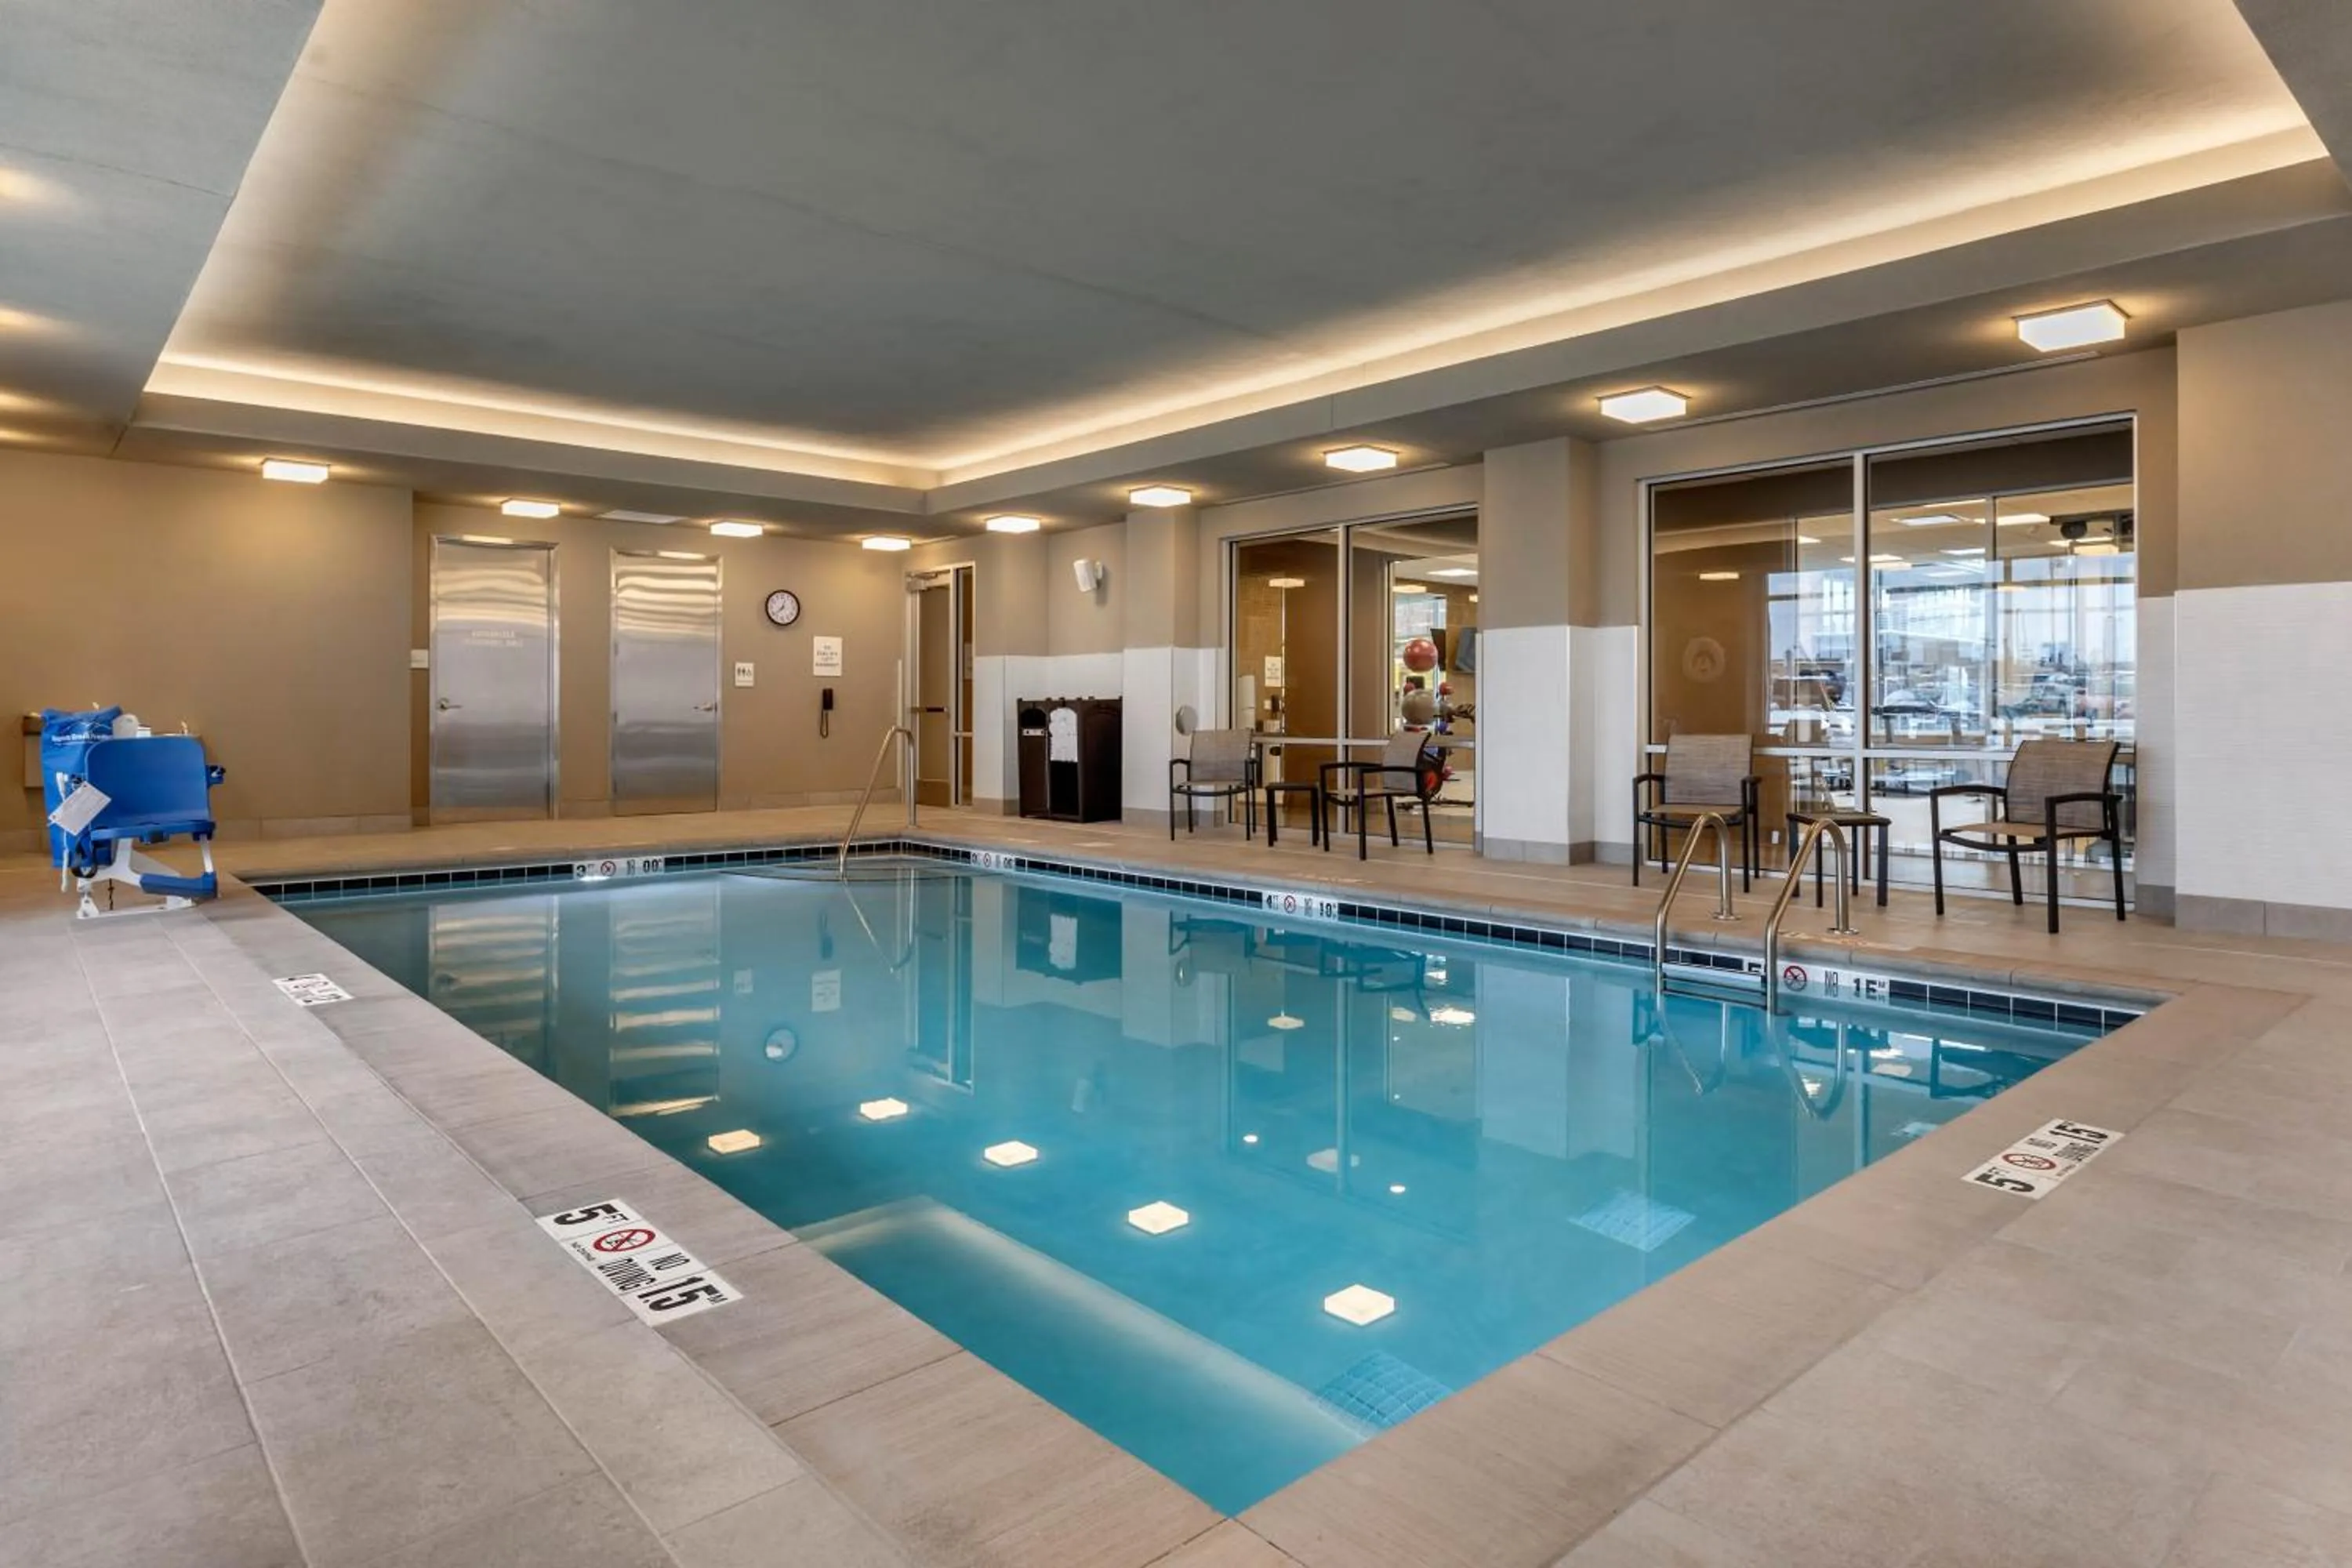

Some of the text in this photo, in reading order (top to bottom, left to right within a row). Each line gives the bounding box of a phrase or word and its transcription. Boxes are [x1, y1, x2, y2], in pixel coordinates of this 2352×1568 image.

[1974, 1173, 2035, 1192] 5
[554, 1203, 619, 1225] 5
[648, 1252, 691, 1271] NO
[597, 1257, 657, 1291] DIVING
[637, 1276, 720, 1312] 1.5
